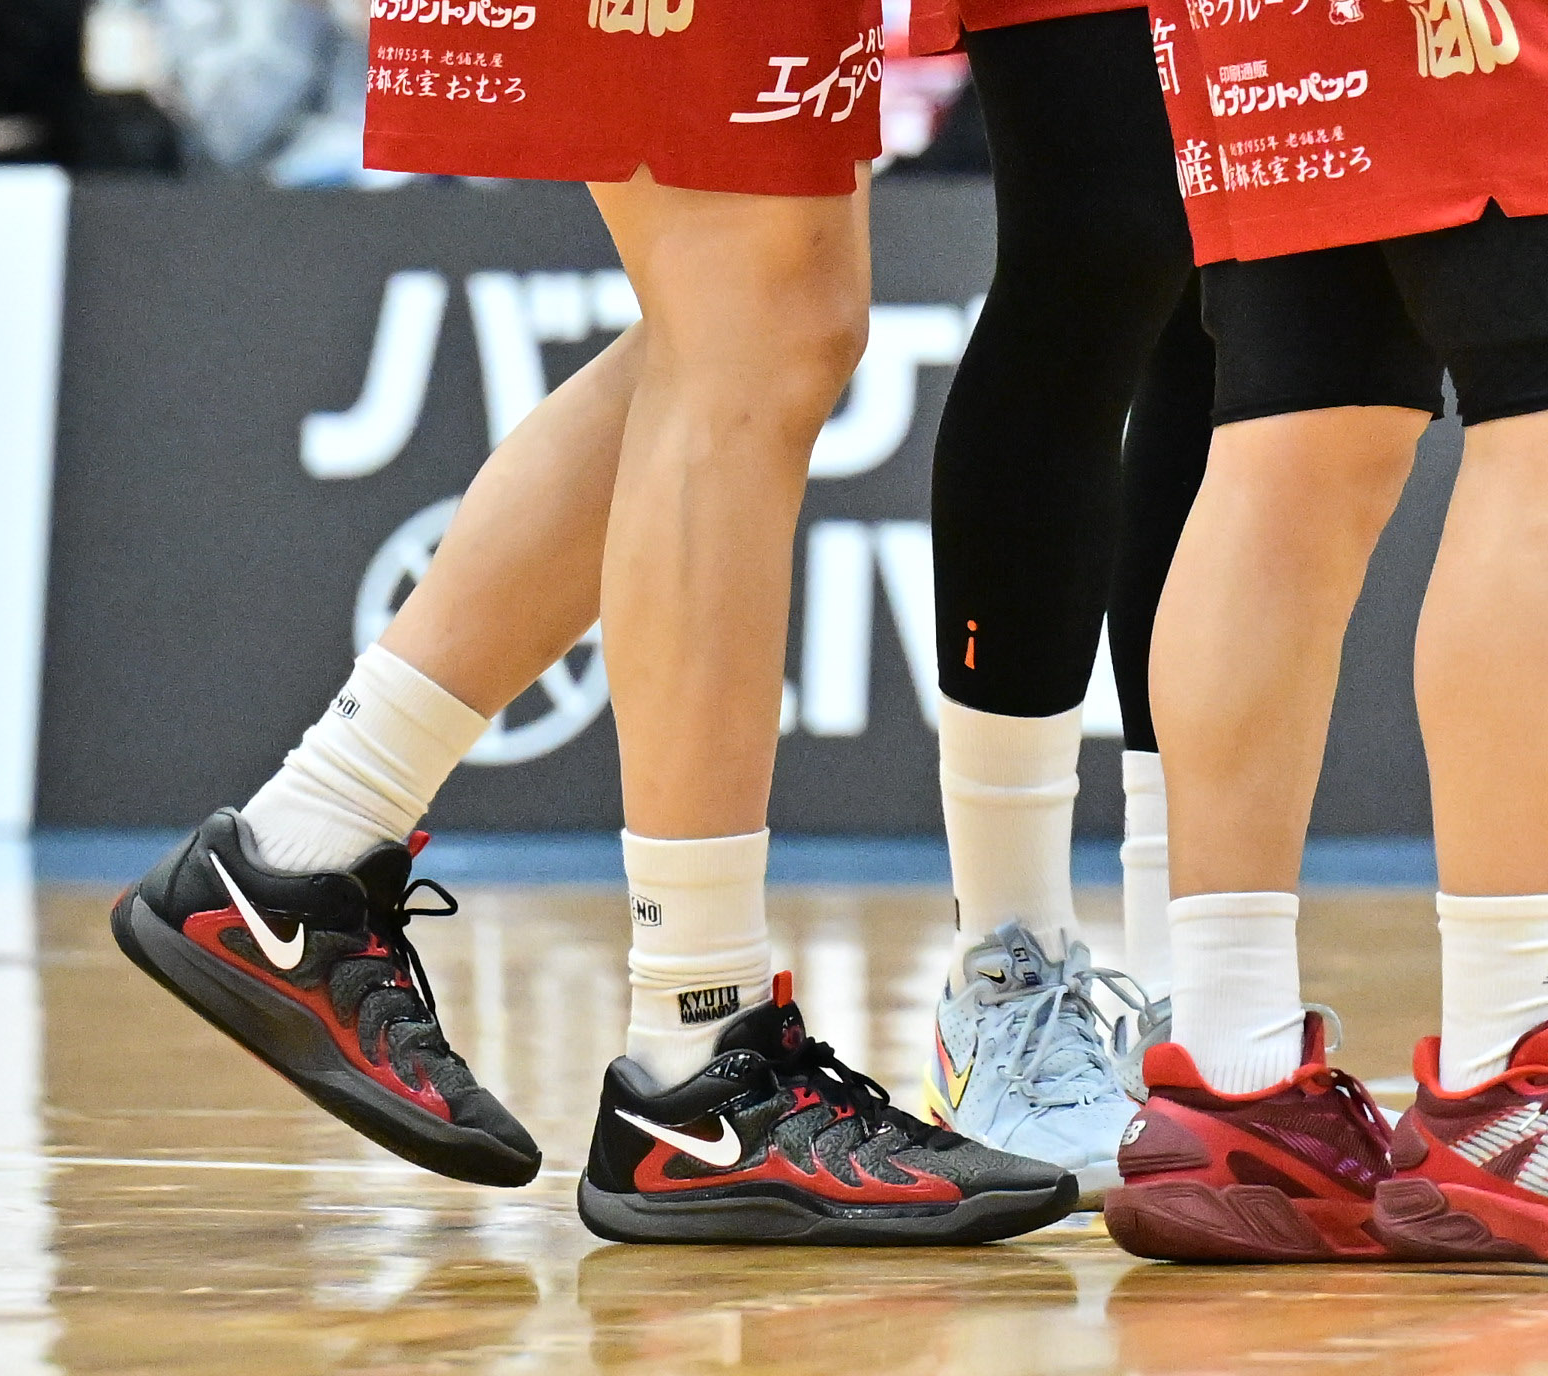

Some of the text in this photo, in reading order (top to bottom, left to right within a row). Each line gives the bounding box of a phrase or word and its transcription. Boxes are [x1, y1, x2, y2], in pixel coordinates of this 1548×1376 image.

[1219, 60, 1269, 84] 印刷通販
[445, 74, 527, 104] おむろ
[1295, 146, 1372, 182] おむろ
